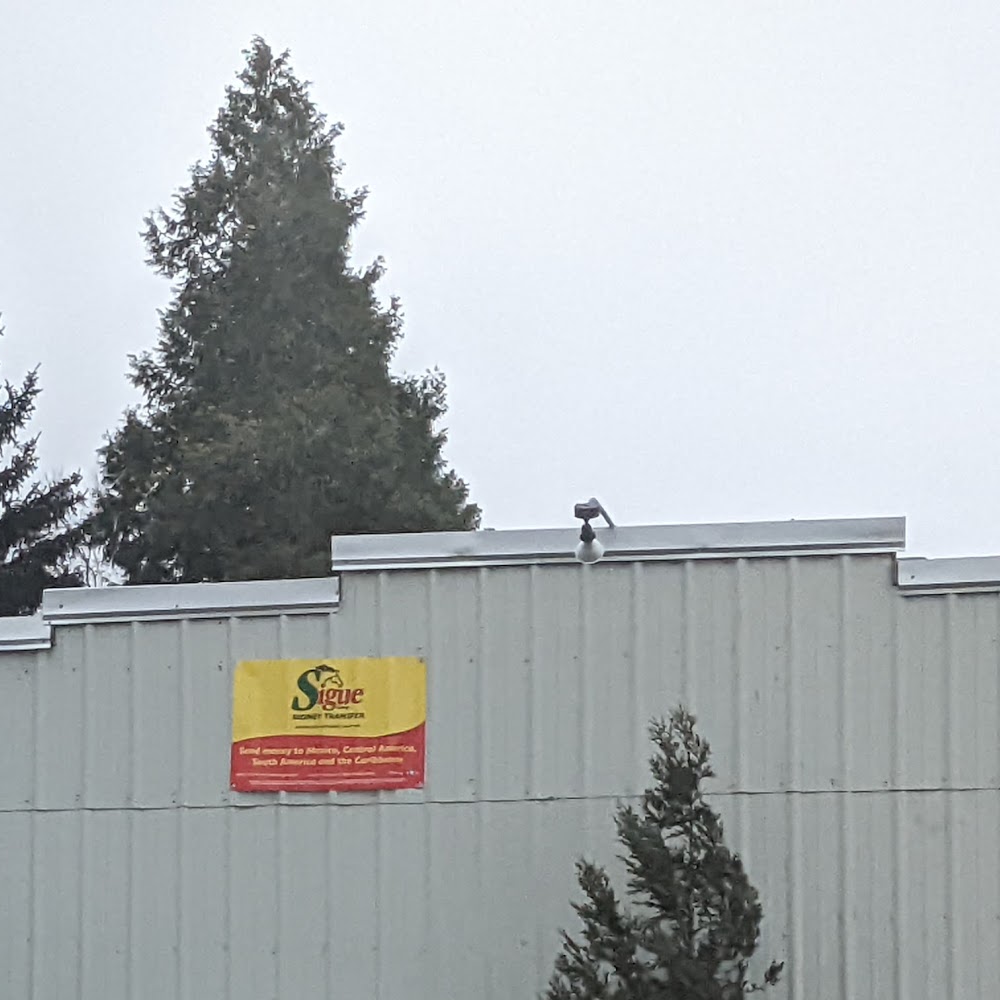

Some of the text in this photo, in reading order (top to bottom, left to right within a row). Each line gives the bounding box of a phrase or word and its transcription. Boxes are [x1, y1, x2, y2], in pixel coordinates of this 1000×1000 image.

[291, 668, 364, 711] Sigue
[292, 712, 365, 721] MONEY TRANSFER
[239, 746, 261, 755] Send
[263, 747, 291, 756] money
[294, 746, 304, 755] to
[343, 745, 376, 754] Central
[252, 758, 278, 767] South
[279, 758, 316, 766] America
[318, 757, 336, 766] and
[337, 757, 352, 765] the
